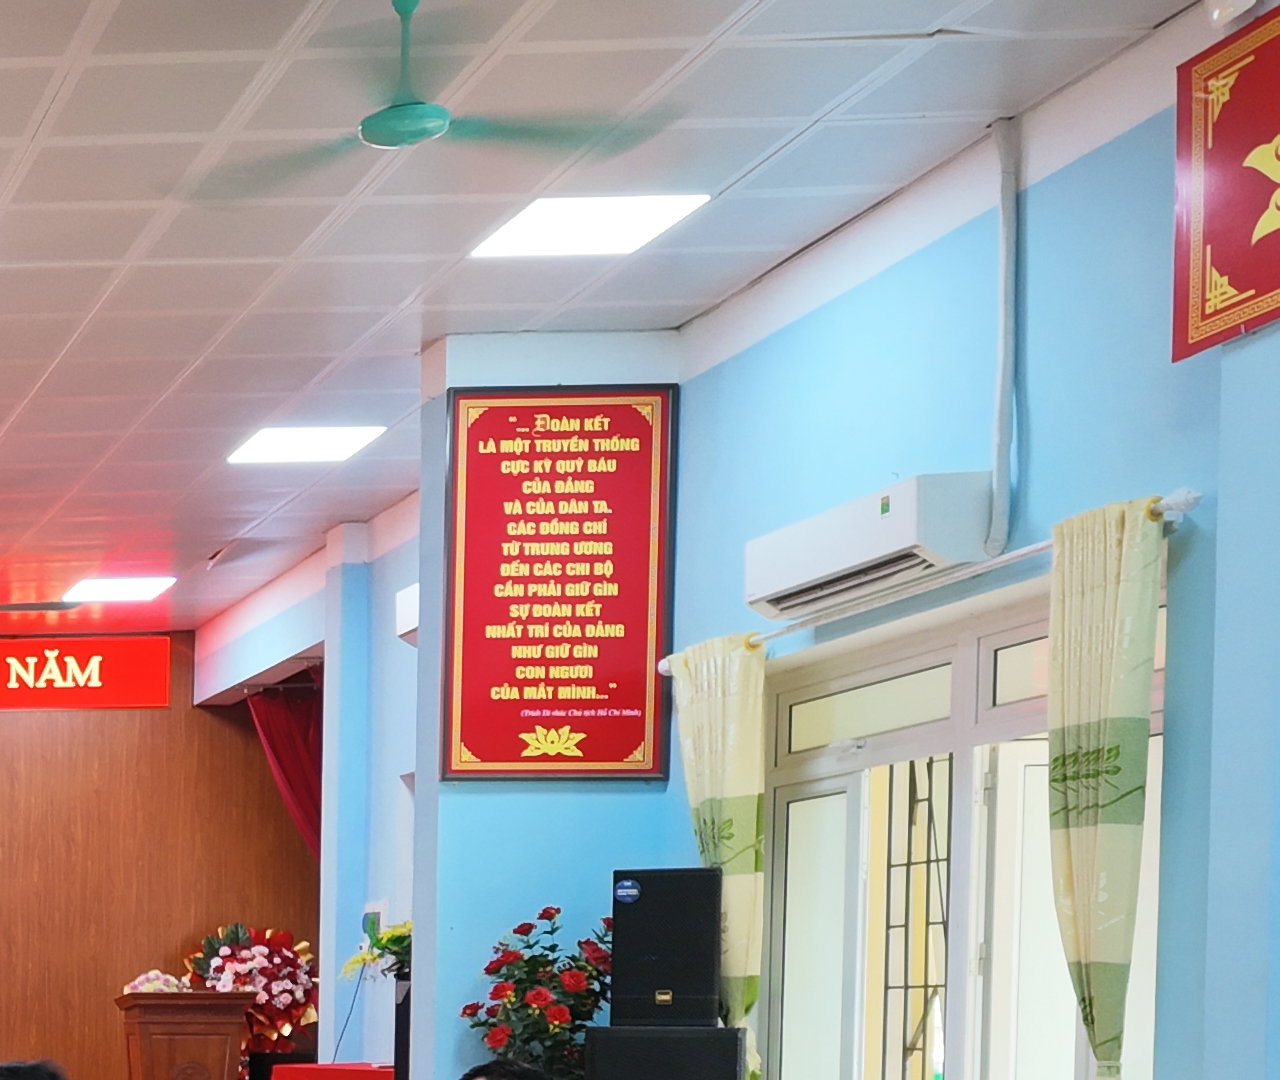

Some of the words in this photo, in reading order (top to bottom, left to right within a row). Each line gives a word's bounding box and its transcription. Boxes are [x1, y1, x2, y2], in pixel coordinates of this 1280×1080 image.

[532, 413, 580, 437] ĐOÀN
[584, 413, 611, 432] KẾT
[479, 438, 496, 453] LÀ
[500, 438, 531, 455] MỘT
[593, 436, 639, 451] THỐNG
[501, 460, 529, 476] CỰC
[588, 457, 616, 472] BÁU
[522, 477, 551, 494] CỦA
[555, 476, 594, 493] ĐẢNG
[504, 499, 522, 515] VÀ
[526, 498, 555, 514] CỦA
[559, 499, 588, 514] DÂN
[507, 520, 536, 535] CÁC
[583, 519, 607, 534] CHÍ
[502, 540, 521, 556] TỪ
[523, 542, 570, 555] TRUNG
[574, 541, 613, 555] ƯƠNG
[500, 560, 529, 576] ĐẾN
[533, 561, 562, 576] CÁC
[566, 563, 590, 576] CHI
[594, 560, 613, 578] BỘ
[528, 580, 561, 596] PHẢI
[565, 581, 591, 596] GIỮ
[593, 579, 618, 596] GÌN
[510, 604, 530, 620] SỰ
[532, 602, 572, 617] ĐOÀN
[576, 600, 602, 617] KẾT
[486, 621, 524, 638] NHẤT
[527, 623, 549, 637] TRÍ
[553, 621, 581, 637] CỦA
[585, 621, 624, 637] ĐẢNG
[512, 644, 543, 658] NHƯ
[545, 643, 571, 658] GIỮ
[573, 643, 598, 658] GÌN
[6, 649, 102, 688] NĂM
[516, 666, 545, 679] CON
[491, 683, 519, 699] CỦA
[524, 682, 554, 699] MẮT
